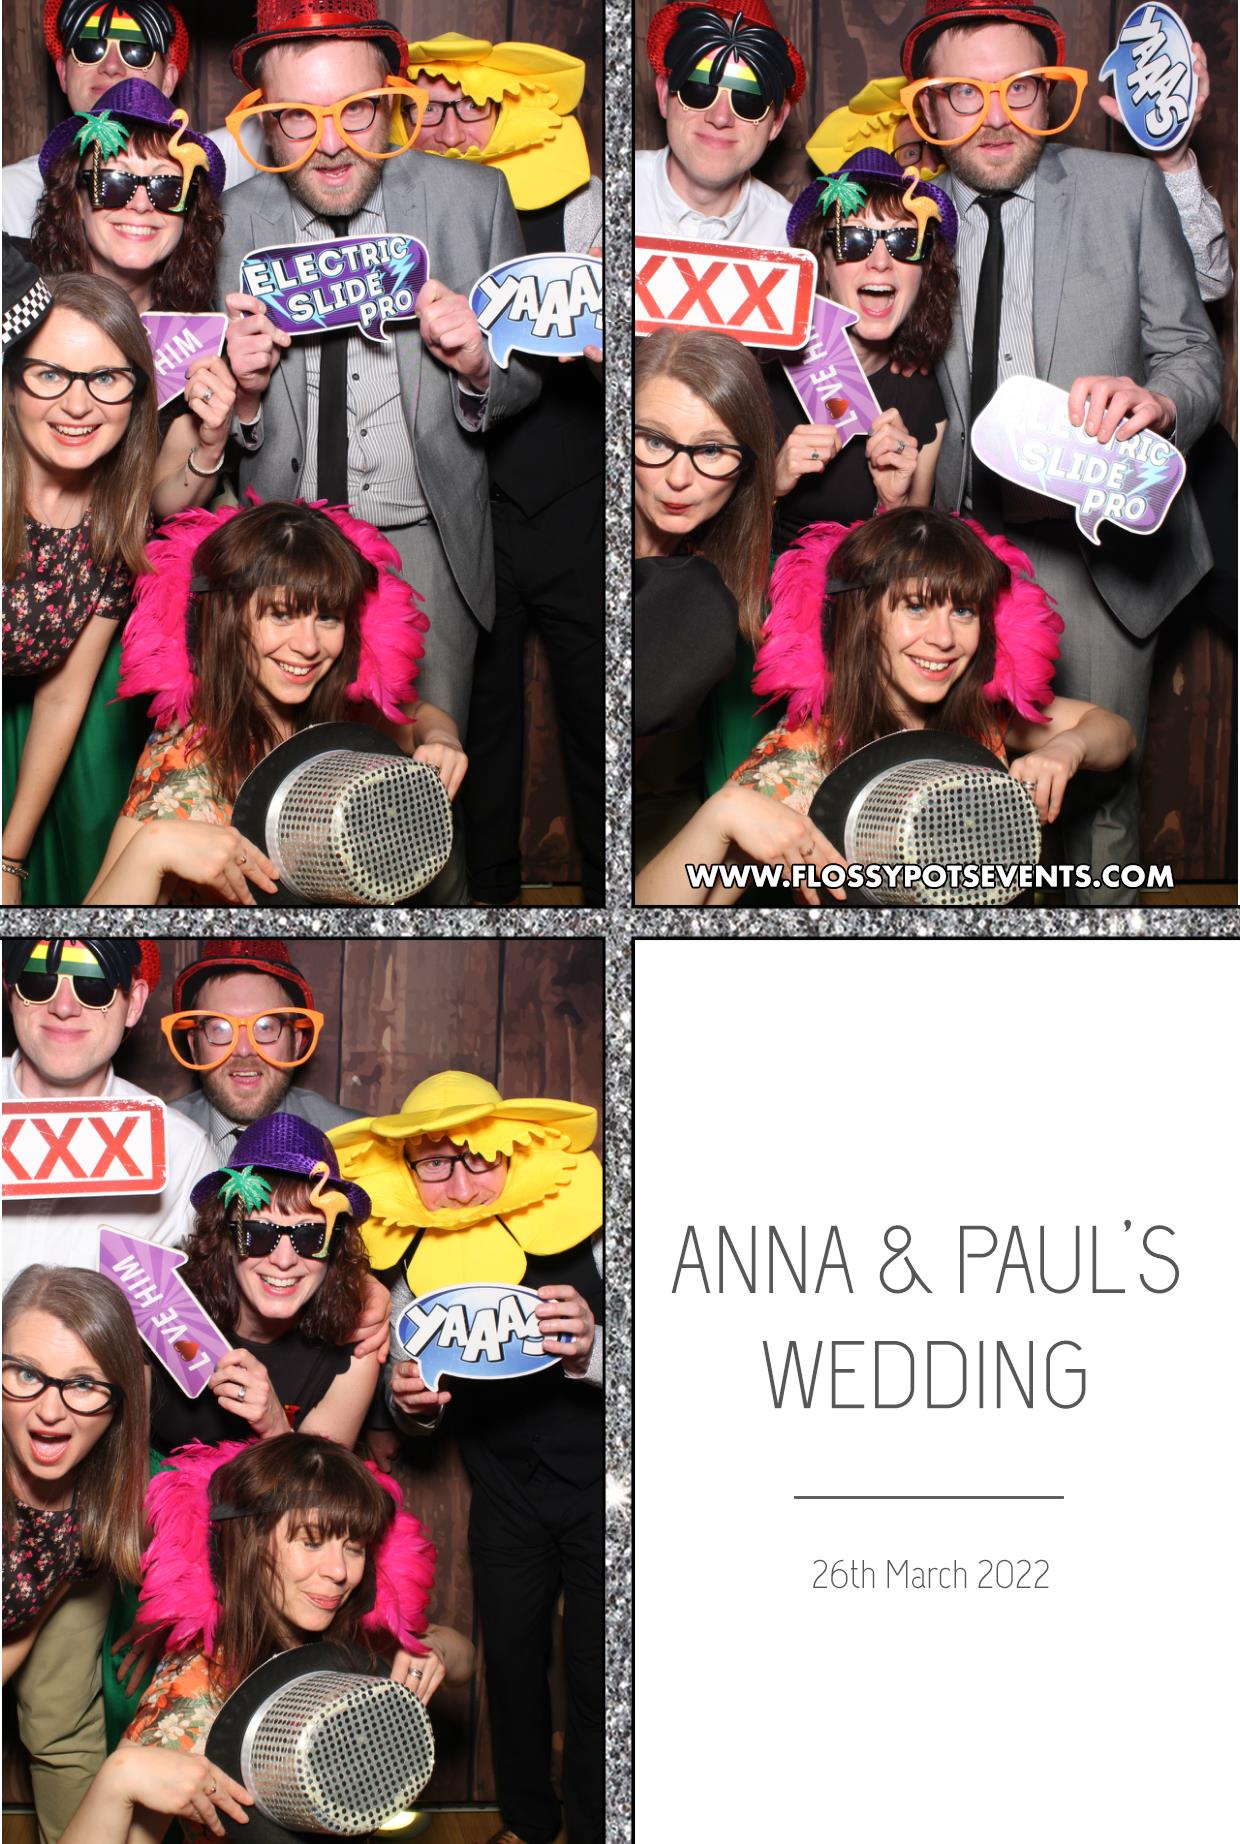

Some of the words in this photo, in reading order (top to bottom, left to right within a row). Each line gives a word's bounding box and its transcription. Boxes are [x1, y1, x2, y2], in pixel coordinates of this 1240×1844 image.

[1119, 5, 1189, 138] YAAAS
[242, 236, 408, 297] ELECTRIC
[287, 271, 385, 322] SLIDE
[359, 288, 413, 328] PRO
[477, 264, 603, 338] YAAA
[155, 327, 204, 376] HIM
[1018, 440, 1129, 490] SLIDE
[1081, 488, 1147, 520] PRO
[112, 1254, 164, 1309] HIM
